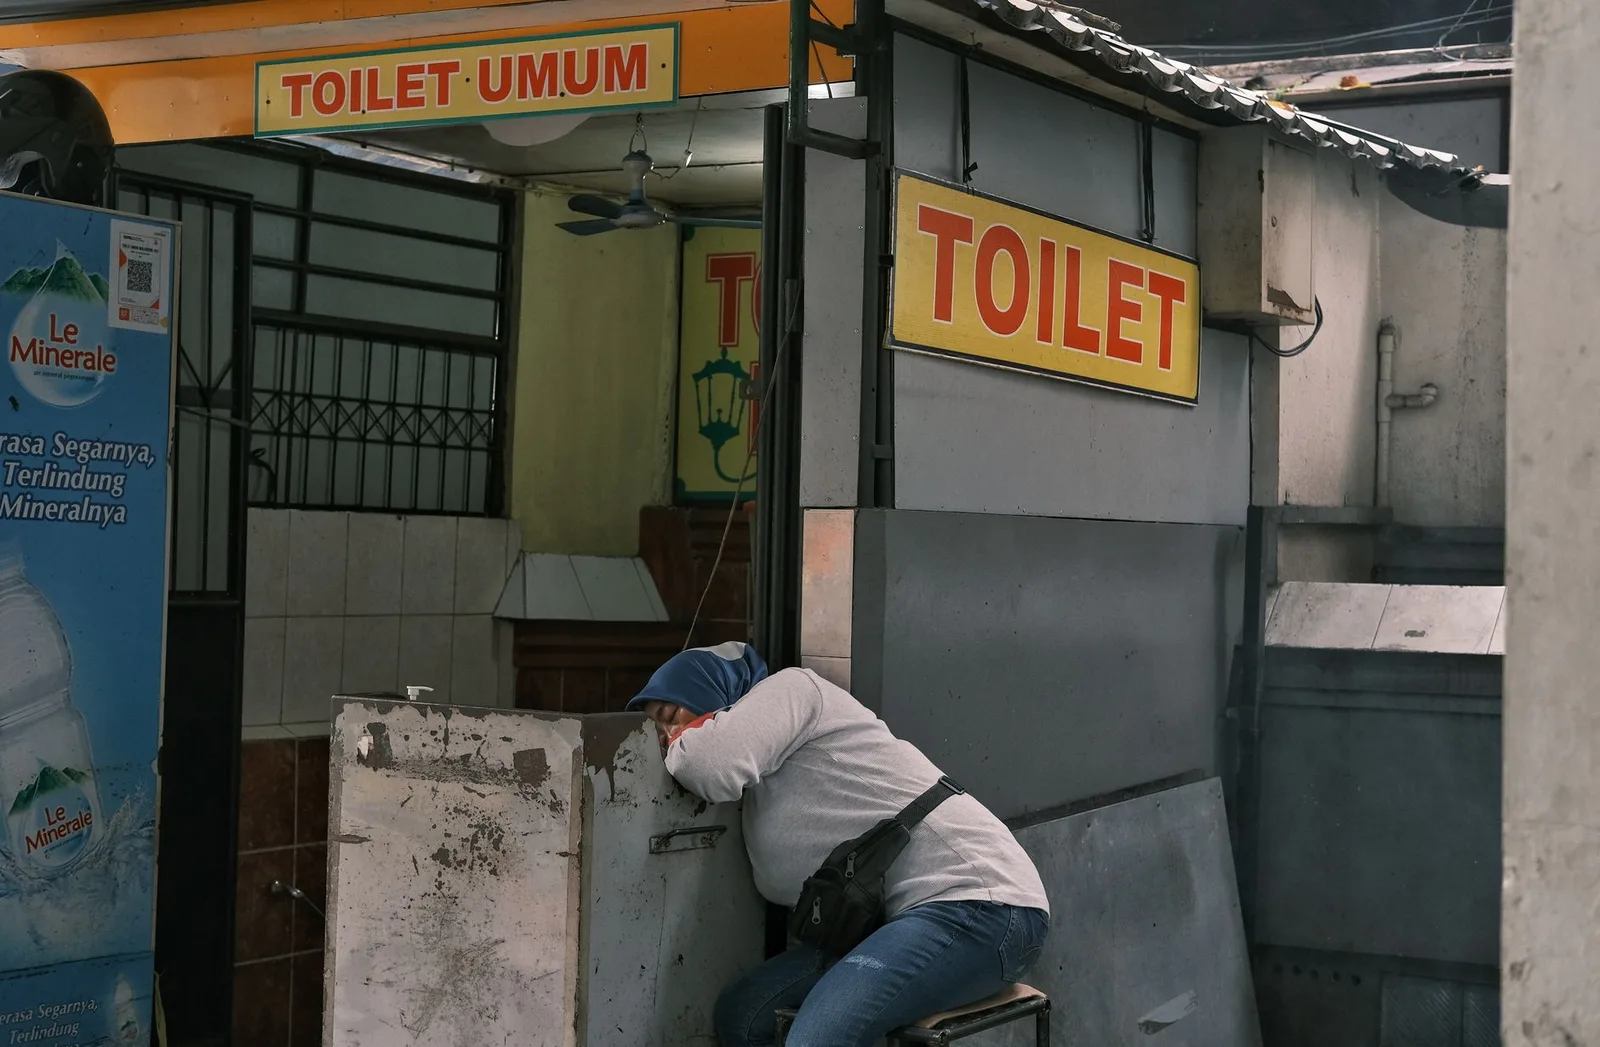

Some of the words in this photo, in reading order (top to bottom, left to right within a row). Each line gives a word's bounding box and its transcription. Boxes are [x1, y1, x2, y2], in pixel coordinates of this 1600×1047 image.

[281, 59, 460, 118] TOILET
[477, 43, 649, 104] UMUM
[916, 203, 1186, 372] TOILET
[50, 314, 79, 345] Le
[10, 335, 117, 373] Minerale
[0, 434, 45, 456] rasa
[52, 432, 155, 467] Segarnya,
[4, 461, 126, 497] Terlindung
[0, 494, 126, 528] Mineralnya
[25, 810, 93, 854] Minerale
[44, 806, 66, 826] Le
[37, 999, 98, 1020] Segarnya,
[9, 1021, 80, 1045] Terlindung
